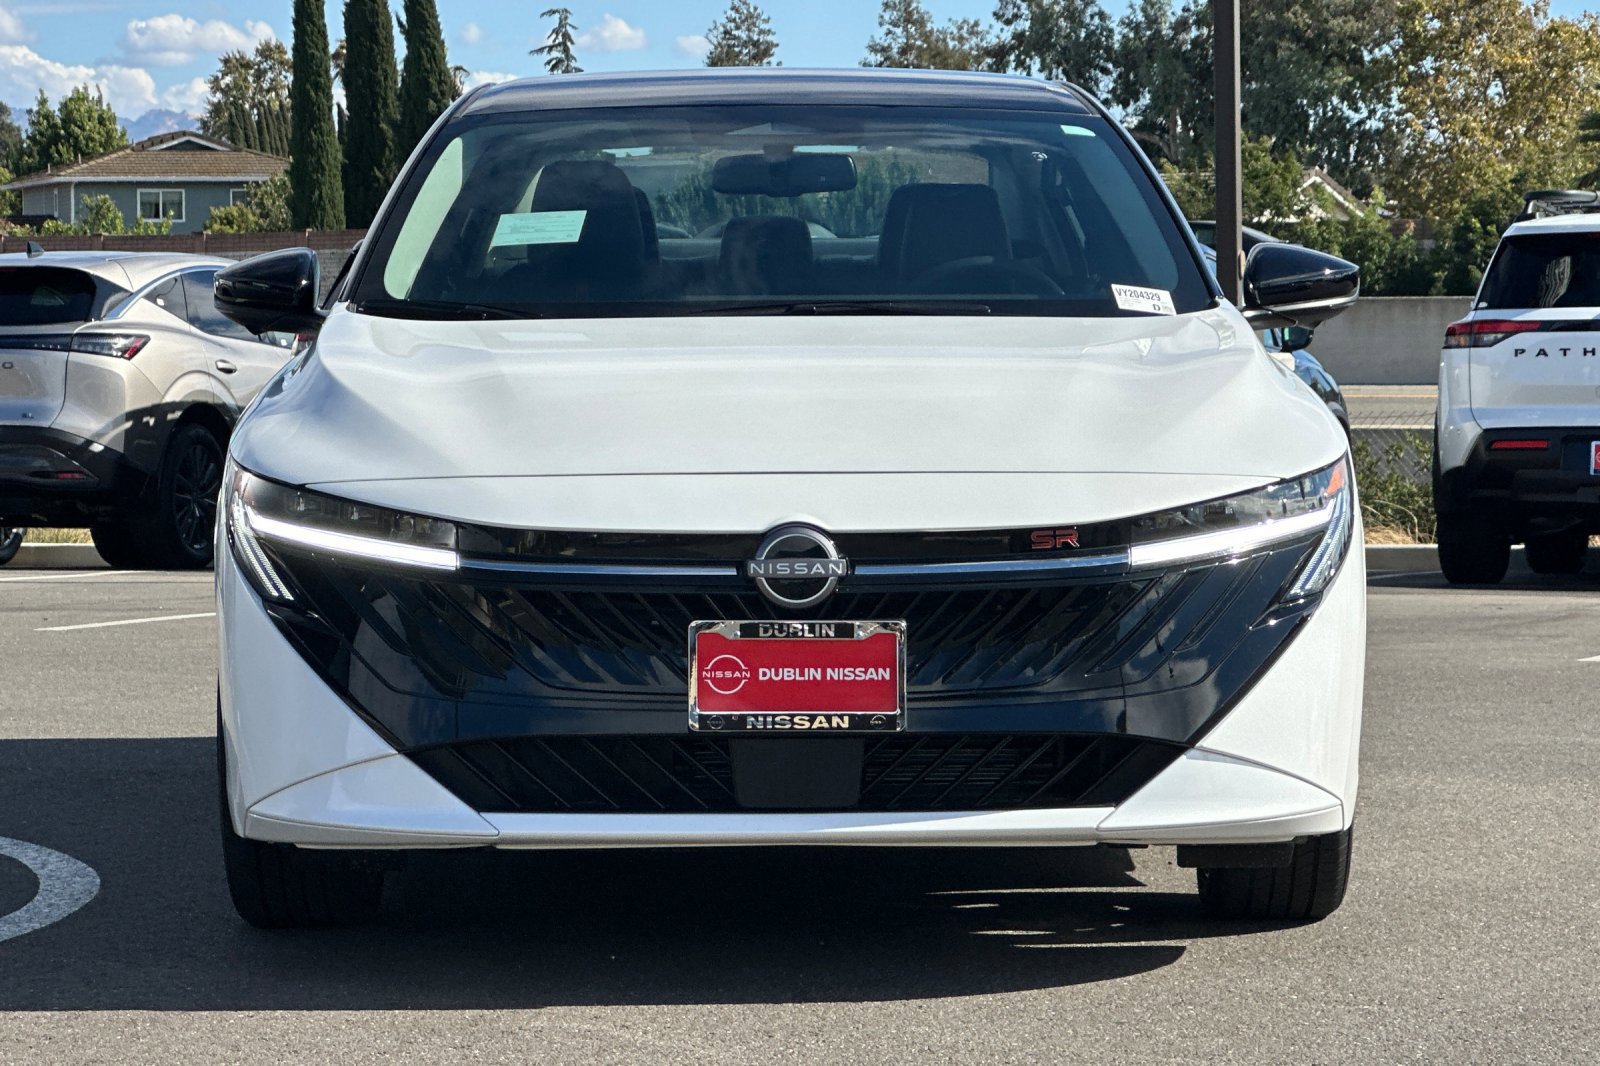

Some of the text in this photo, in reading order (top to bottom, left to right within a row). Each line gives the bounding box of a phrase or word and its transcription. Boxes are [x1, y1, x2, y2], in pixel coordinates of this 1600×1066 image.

[1030, 529, 1080, 549] SR
[750, 563, 843, 575] NISSAN
[758, 623, 835, 638] DUBLIN
[702, 670, 750, 679] NISSAN
[758, 668, 890, 681] DUBLIN NISSAN
[746, 715, 849, 729] NISSAN
